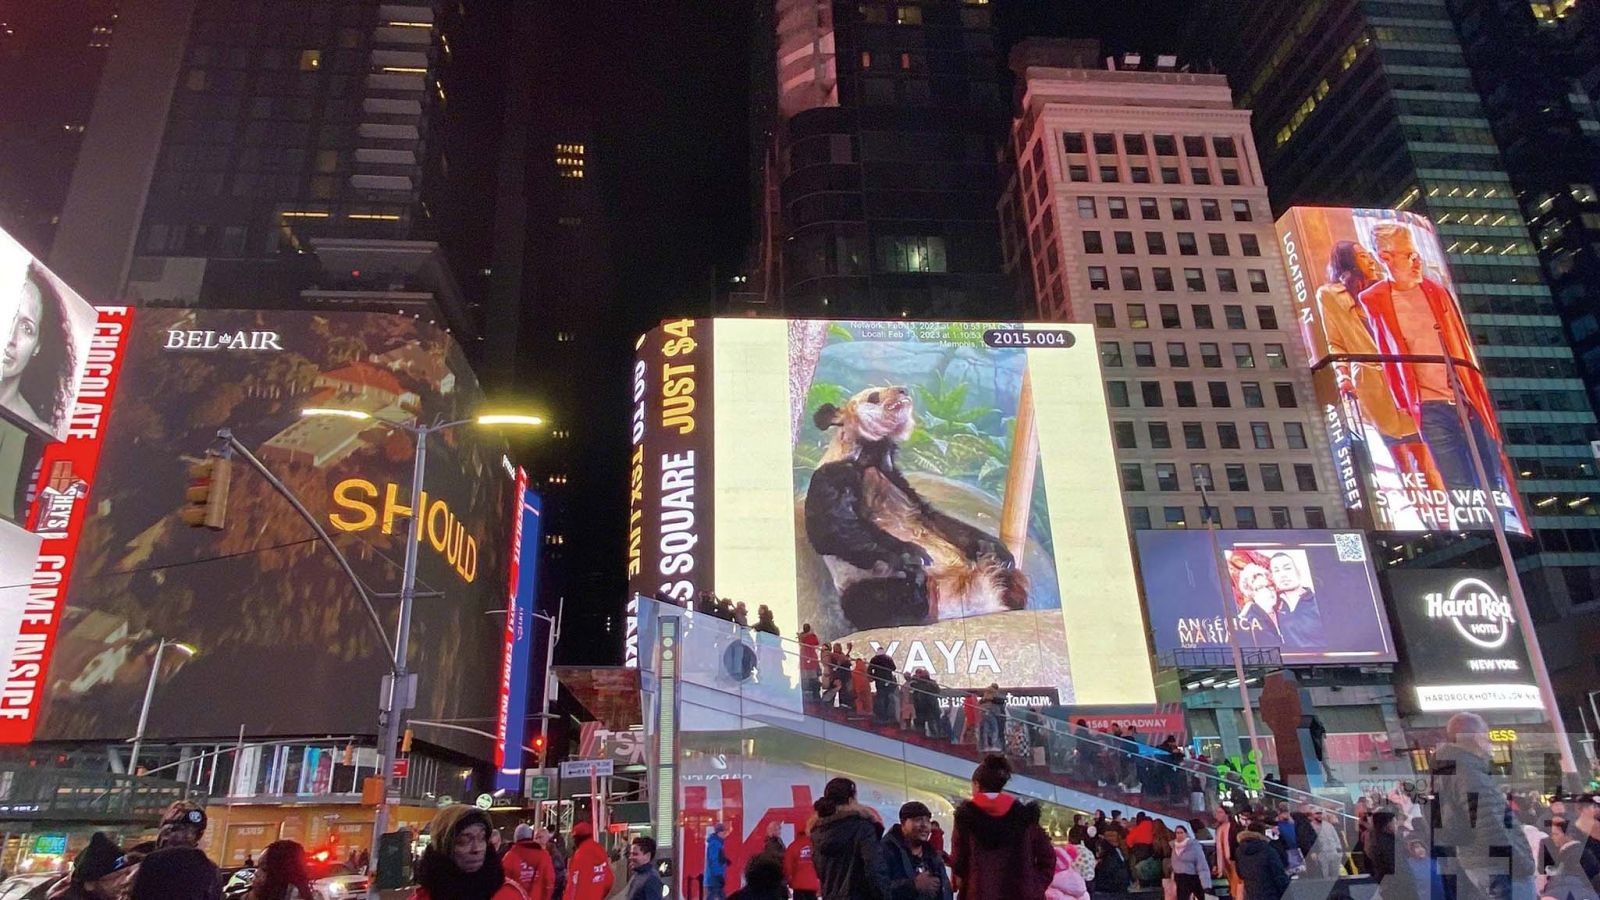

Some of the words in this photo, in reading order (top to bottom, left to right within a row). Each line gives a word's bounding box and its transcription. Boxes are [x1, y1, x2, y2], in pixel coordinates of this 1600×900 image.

[1283, 231, 1307, 303] LOCATED
[1300, 307, 1314, 325] AT
[165, 331, 221, 348] BEL
[228, 331, 283, 349] AIR
[888, 330, 904, 338] Feb
[920, 331, 940, 339] 2023
[993, 332, 1065, 345] 2015.004
[69, 322, 123, 440] CHOCOLATE
[661, 363, 696, 435] JUST
[1337, 447, 1362, 510] STREET
[660, 450, 698, 576] SQUARE
[328, 478, 477, 584] SHOULD
[23, 555, 66, 625] COME
[1424, 592, 1477, 618] Hard
[1478, 593, 1516, 624] Rock
[1471, 624, 1500, 634] HOTEL
[869, 640, 1002, 674] YAYA
[1467, 659, 1494, 671] NEW
[1495, 659, 1520, 671] YORK
[1086, 720, 1109, 729] 1568
